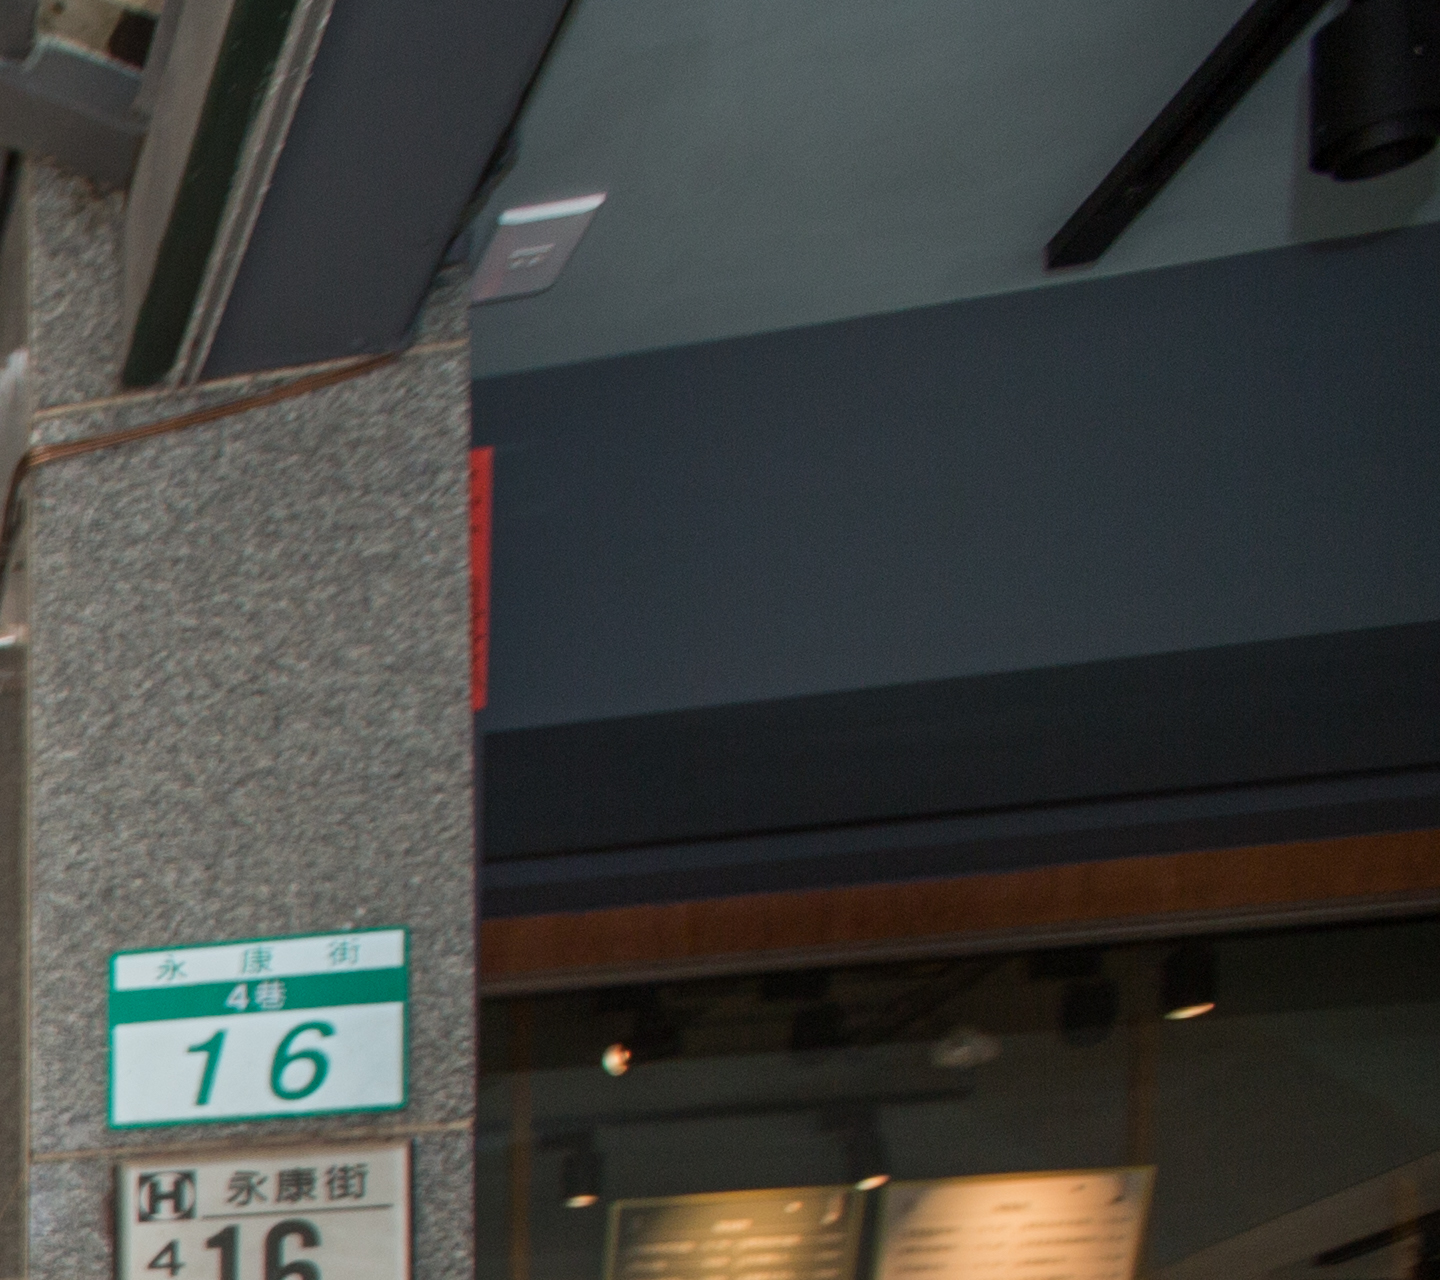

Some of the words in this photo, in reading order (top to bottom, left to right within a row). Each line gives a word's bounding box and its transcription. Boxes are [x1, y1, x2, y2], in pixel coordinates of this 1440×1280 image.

[155, 939, 361, 982] 永康街
[226, 981, 287, 1011] 4巷
[186, 1020, 337, 1107] 16
[227, 1163, 368, 1206] 永康街
